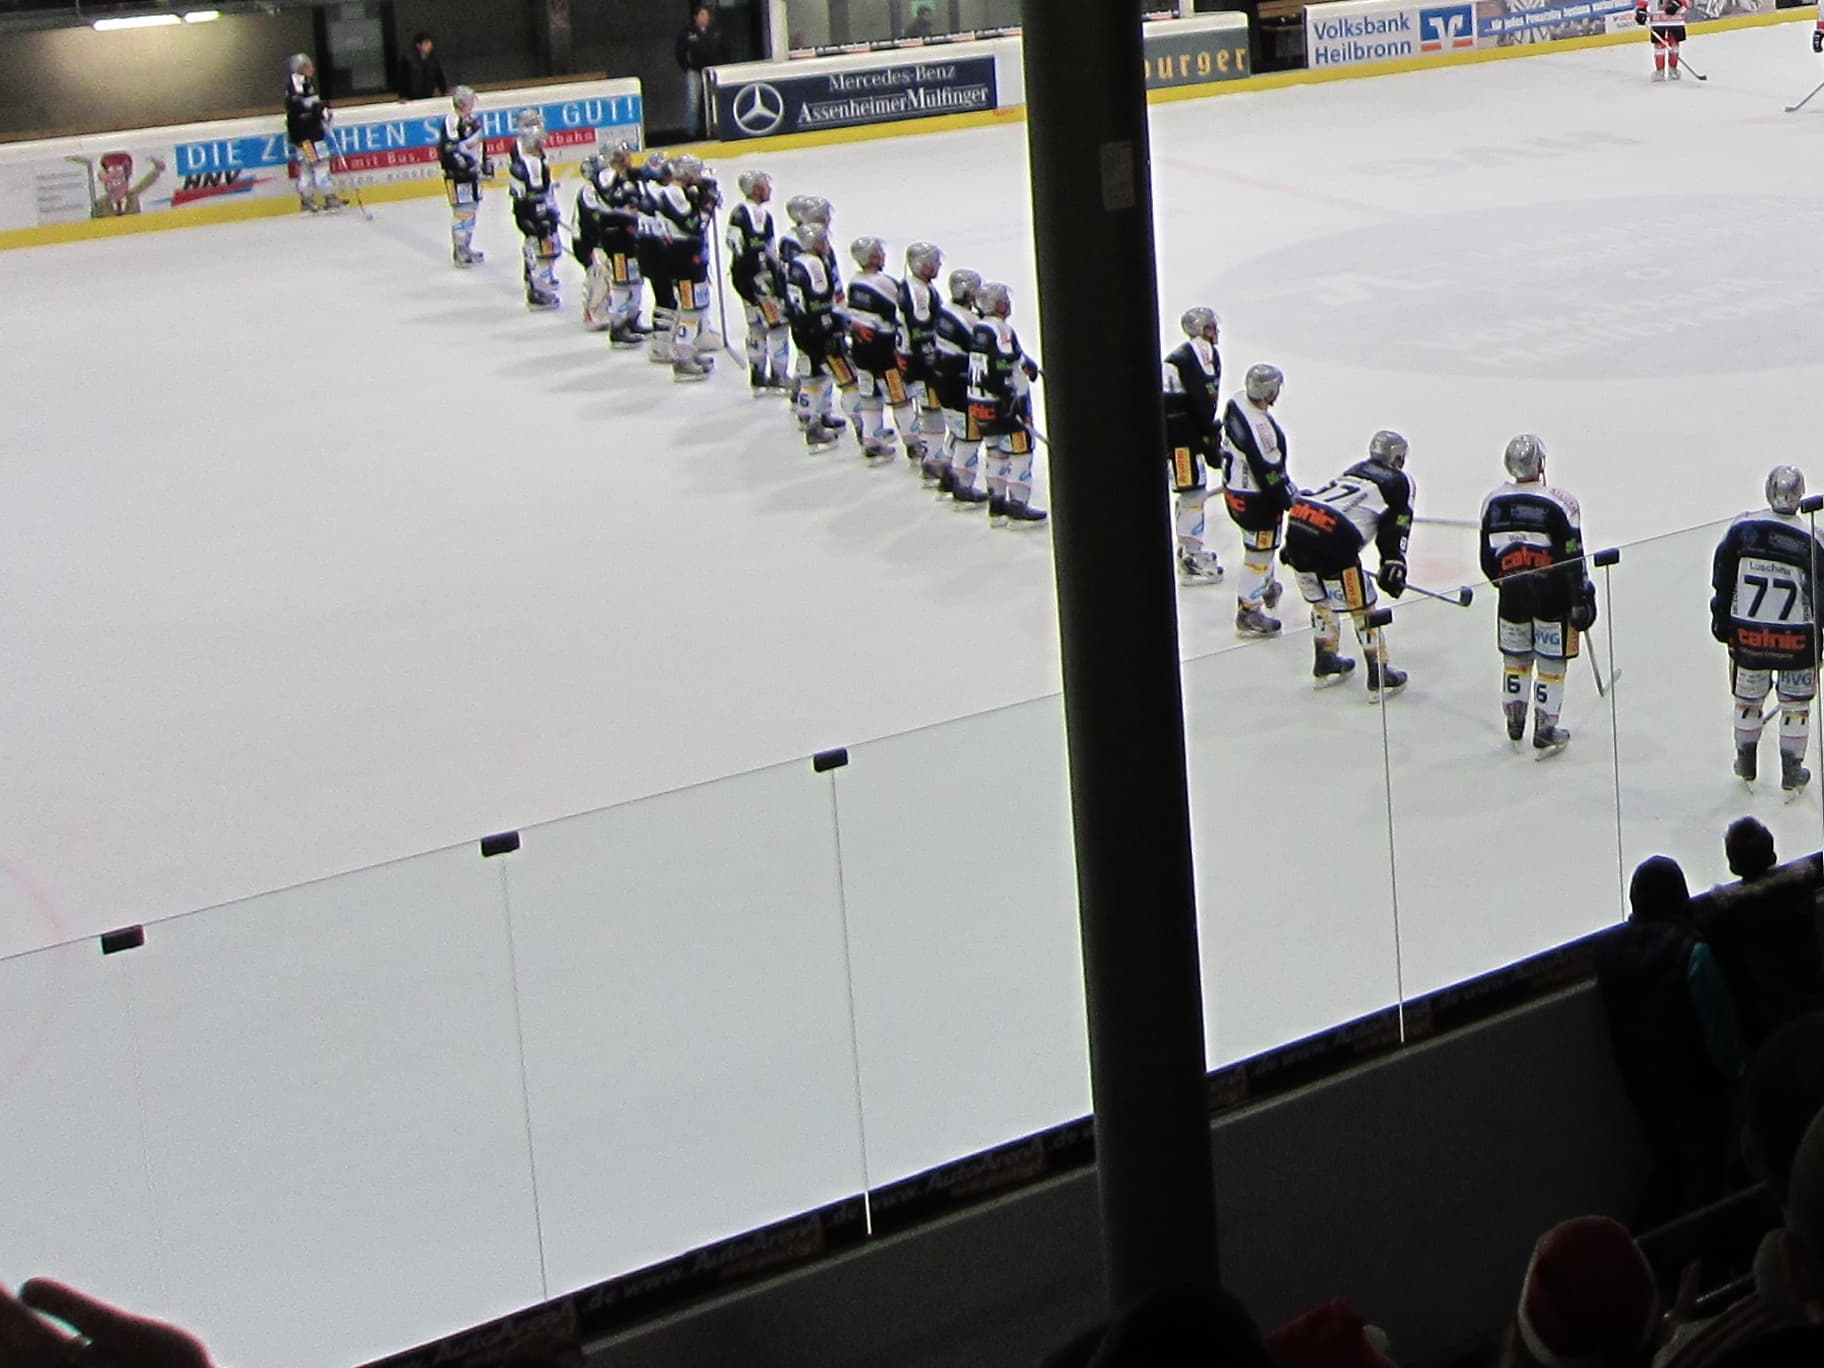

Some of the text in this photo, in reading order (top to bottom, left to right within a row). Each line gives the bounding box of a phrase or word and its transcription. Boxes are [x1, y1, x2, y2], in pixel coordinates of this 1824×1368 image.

[1313, 13, 1411, 41] Volksbank
[1142, 46, 1250, 79] urger
[1314, 40, 1412, 66] Heilbronn
[828, 64, 957, 93] Mercedes-Benz
[188, 139, 243, 170] DIE
[562, 96, 635, 129] GUT!
[184, 168, 242, 191] HNV
[1744, 574, 1798, 621] 77
[1780, 671, 1813, 686] HVG
